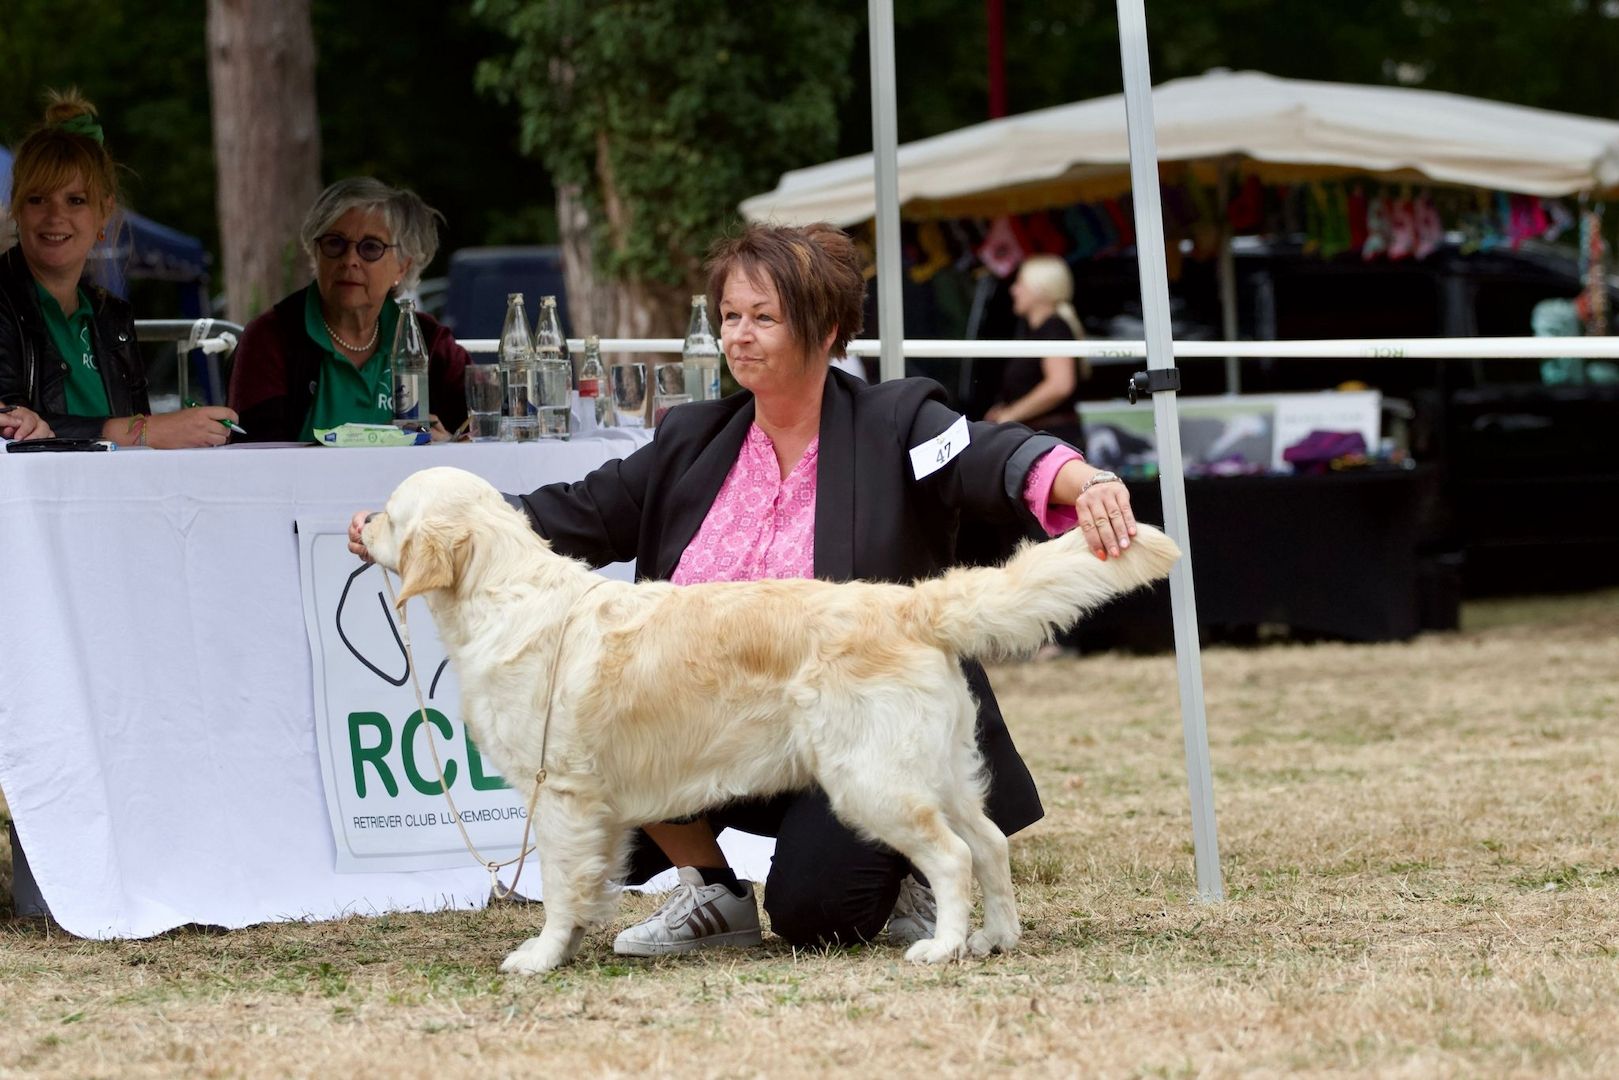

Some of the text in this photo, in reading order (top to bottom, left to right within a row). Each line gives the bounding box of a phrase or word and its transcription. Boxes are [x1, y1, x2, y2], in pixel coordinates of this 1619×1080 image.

[82, 353, 98, 370] RC
[936, 441, 951, 463] 47
[347, 707, 514, 799] RCL
[353, 806, 528, 829] RETRIEVER CLUB LUXEMBOURG
